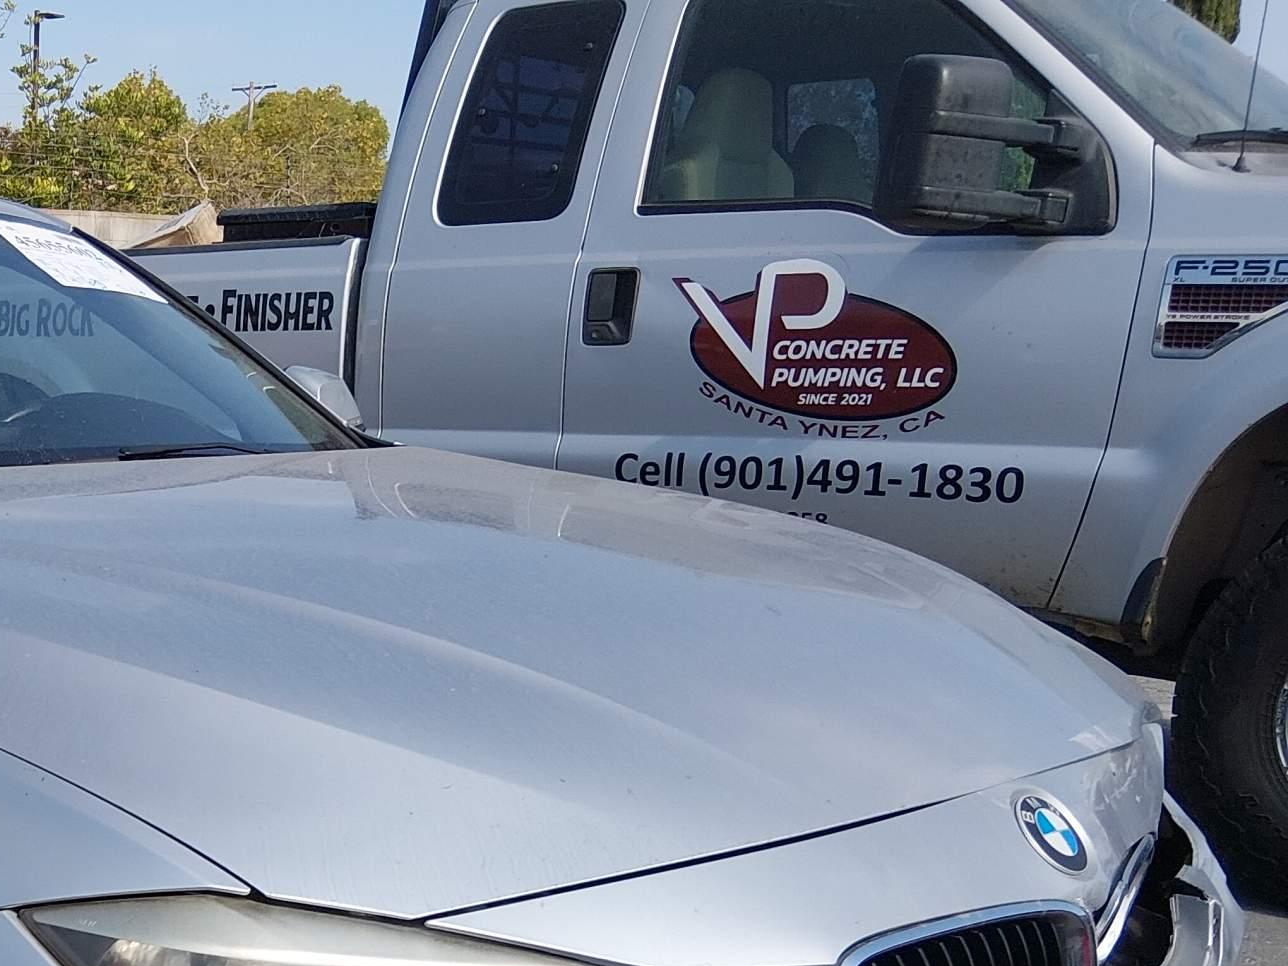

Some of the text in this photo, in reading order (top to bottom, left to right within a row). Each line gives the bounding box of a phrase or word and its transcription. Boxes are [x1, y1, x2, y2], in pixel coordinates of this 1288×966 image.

[35, 298, 95, 337] ROCK
[220, 289, 334, 332] FINISHER
[771, 338, 909, 360] CONCRETE
[770, 367, 945, 390] PUMPING, LLC
[699, 381, 946, 440] SANTA YNEZ, CA
[797, 393, 873, 406] SINCE 2021
[614, 451, 1025, 504] Cell (901)491-1830
